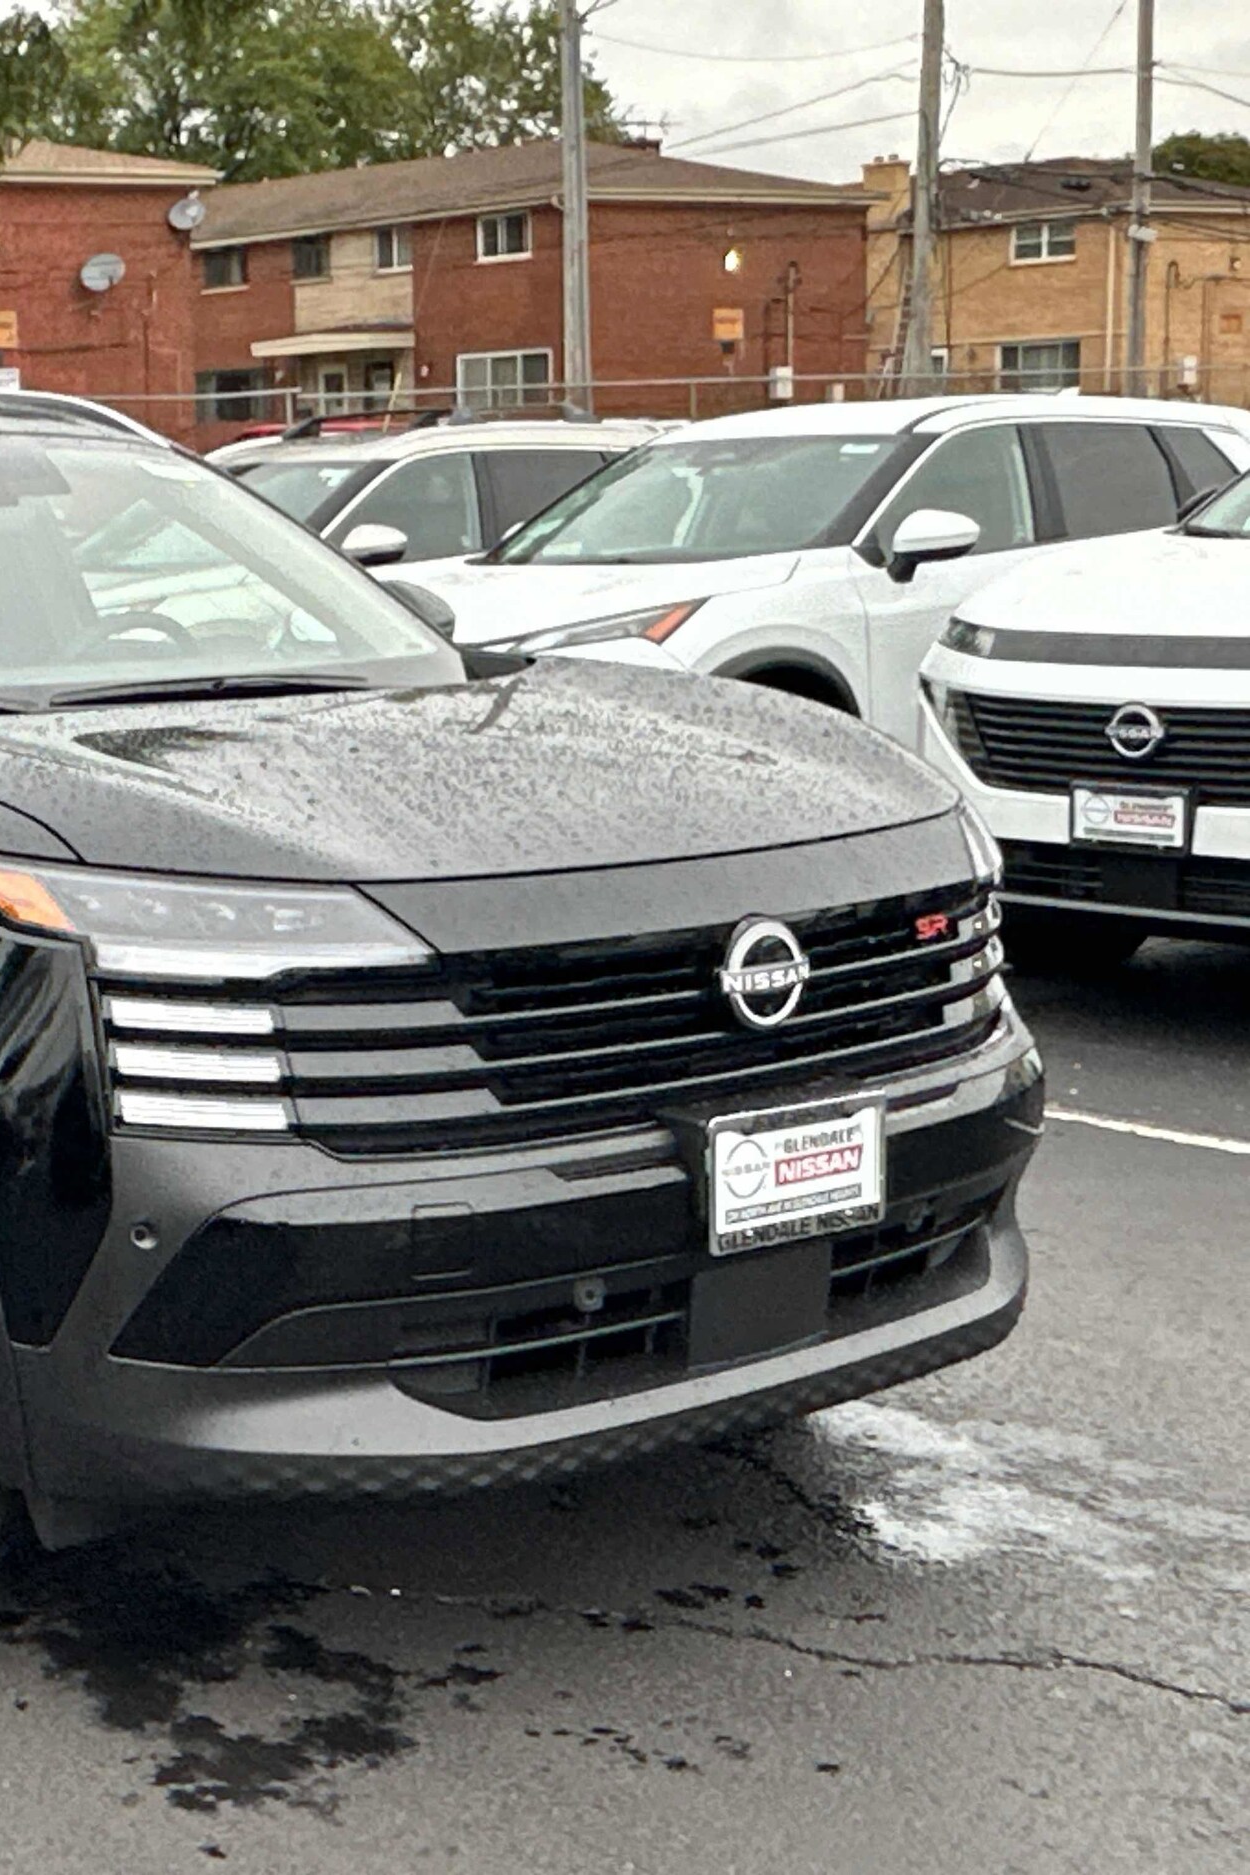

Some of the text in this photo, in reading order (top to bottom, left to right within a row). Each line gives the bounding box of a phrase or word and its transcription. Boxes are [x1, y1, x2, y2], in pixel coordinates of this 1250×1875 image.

[722, 963, 810, 994] NISSAN
[783, 1126, 855, 1153] GLENDALE
[779, 1149, 858, 1183] NISSAN
[718, 1217, 811, 1251] GLENDALE
